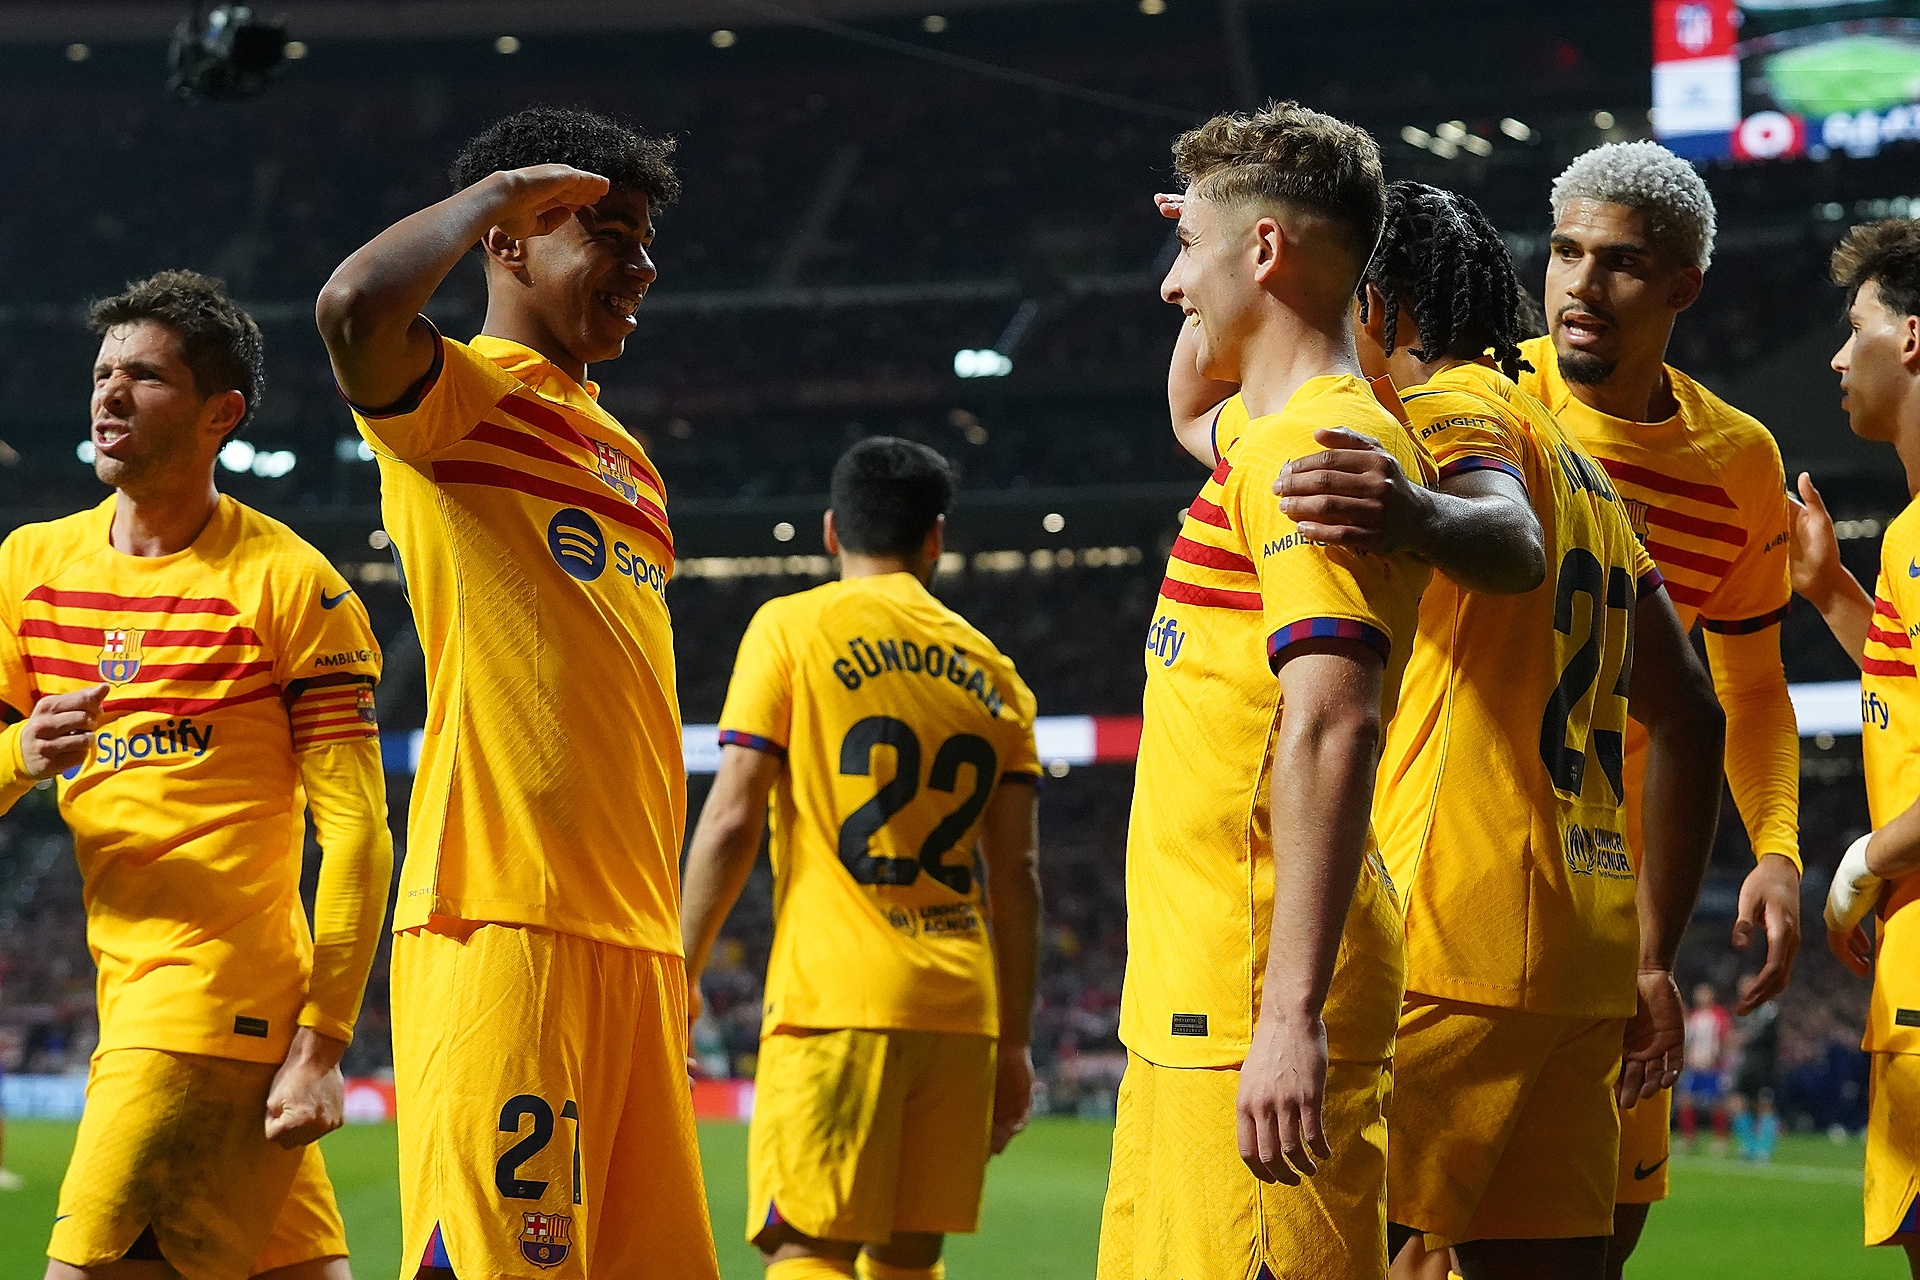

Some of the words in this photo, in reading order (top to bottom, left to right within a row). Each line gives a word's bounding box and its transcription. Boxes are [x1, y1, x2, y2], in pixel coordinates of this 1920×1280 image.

[1421, 417, 1486, 440] BILIGHT
[96, 718, 214, 770] Spotify
[838, 715, 998, 894] 22
